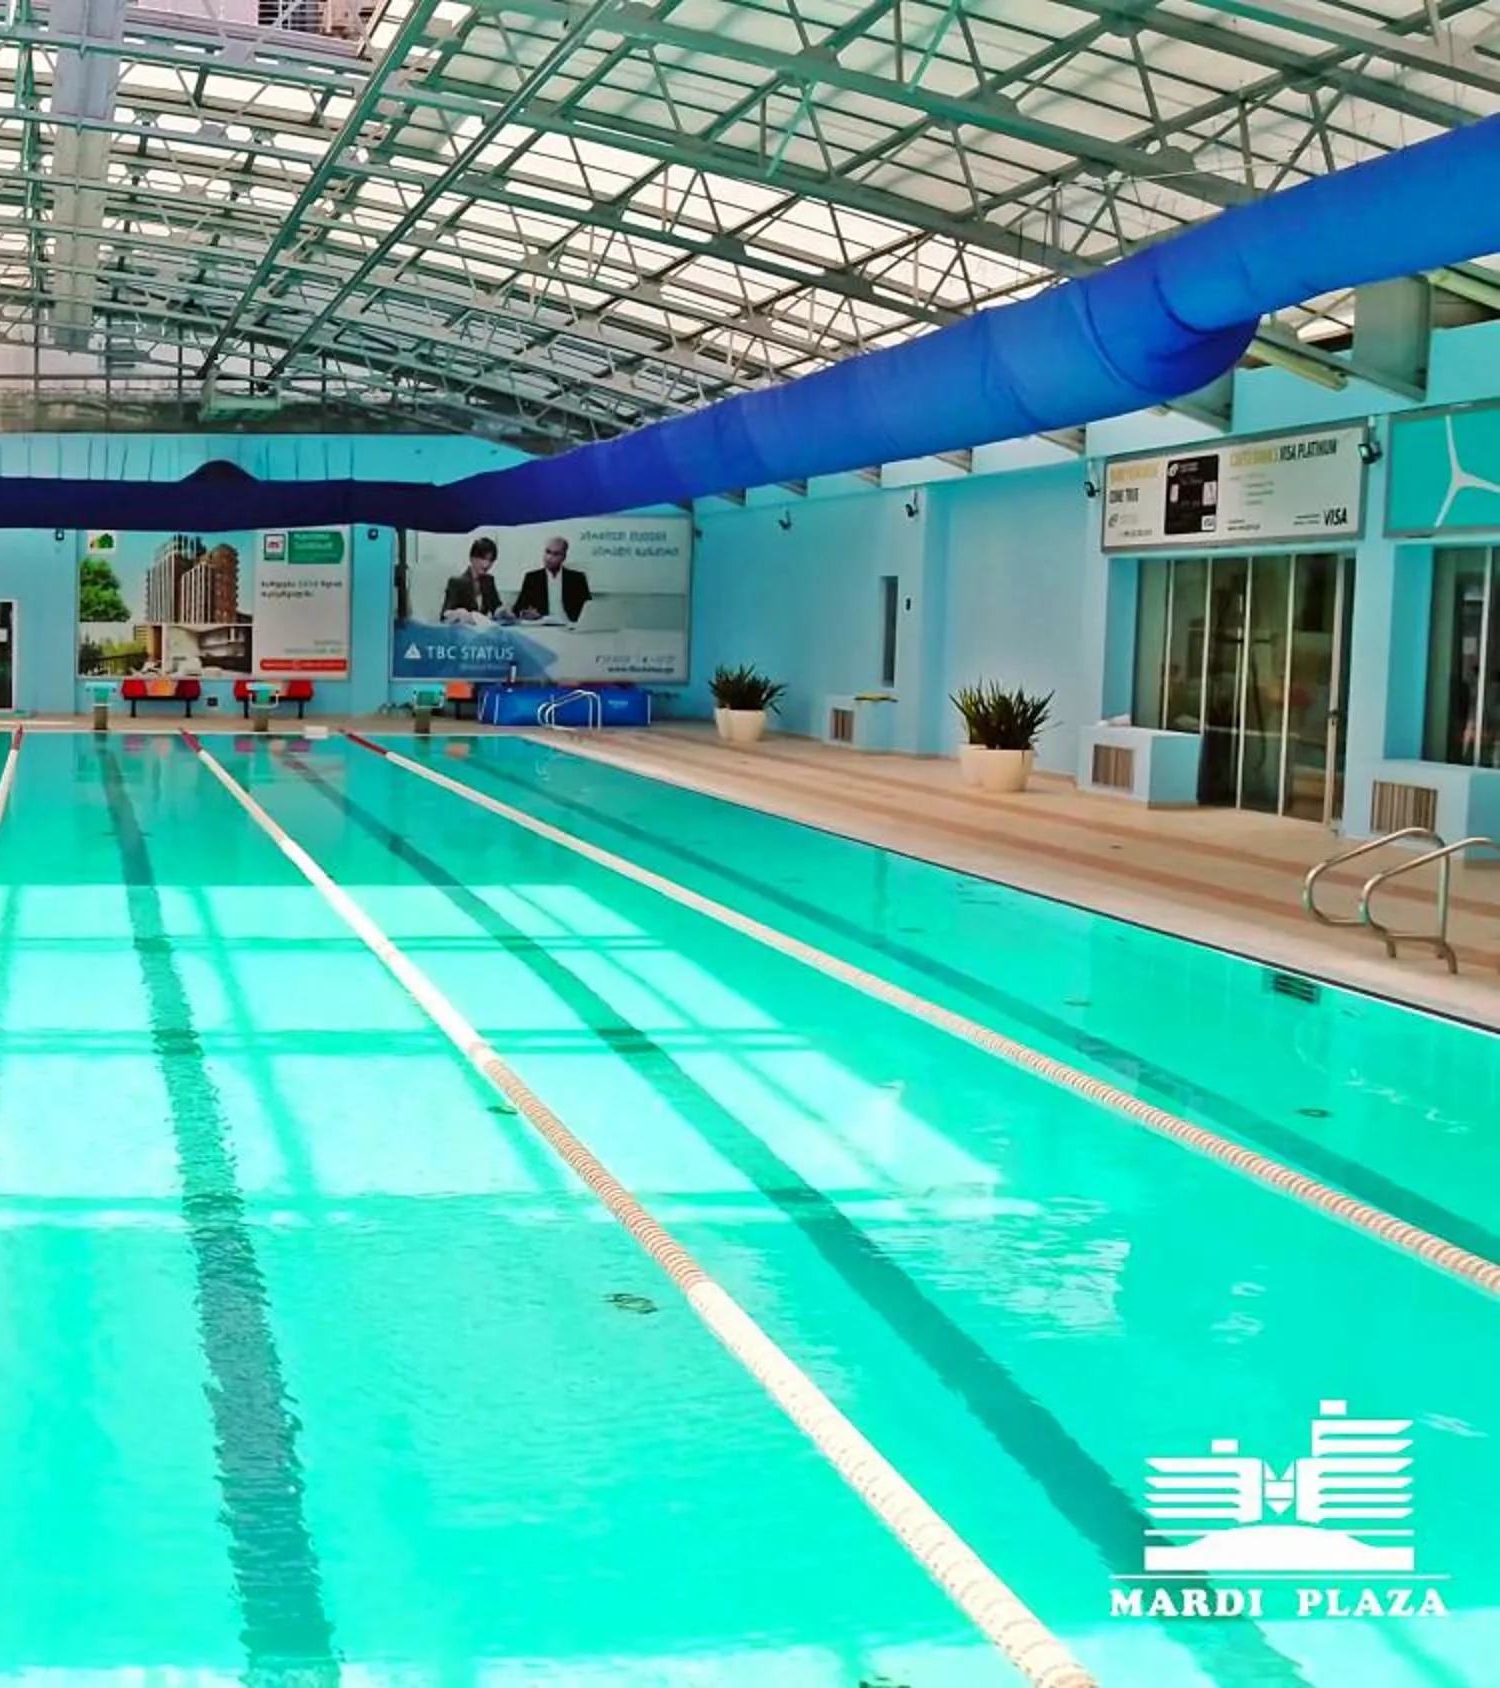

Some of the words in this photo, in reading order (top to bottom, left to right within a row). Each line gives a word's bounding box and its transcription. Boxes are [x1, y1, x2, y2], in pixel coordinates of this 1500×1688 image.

[1322, 507, 1348, 527] VISA
[425, 644, 458, 660] TBC
[461, 645, 515, 661] STATUS
